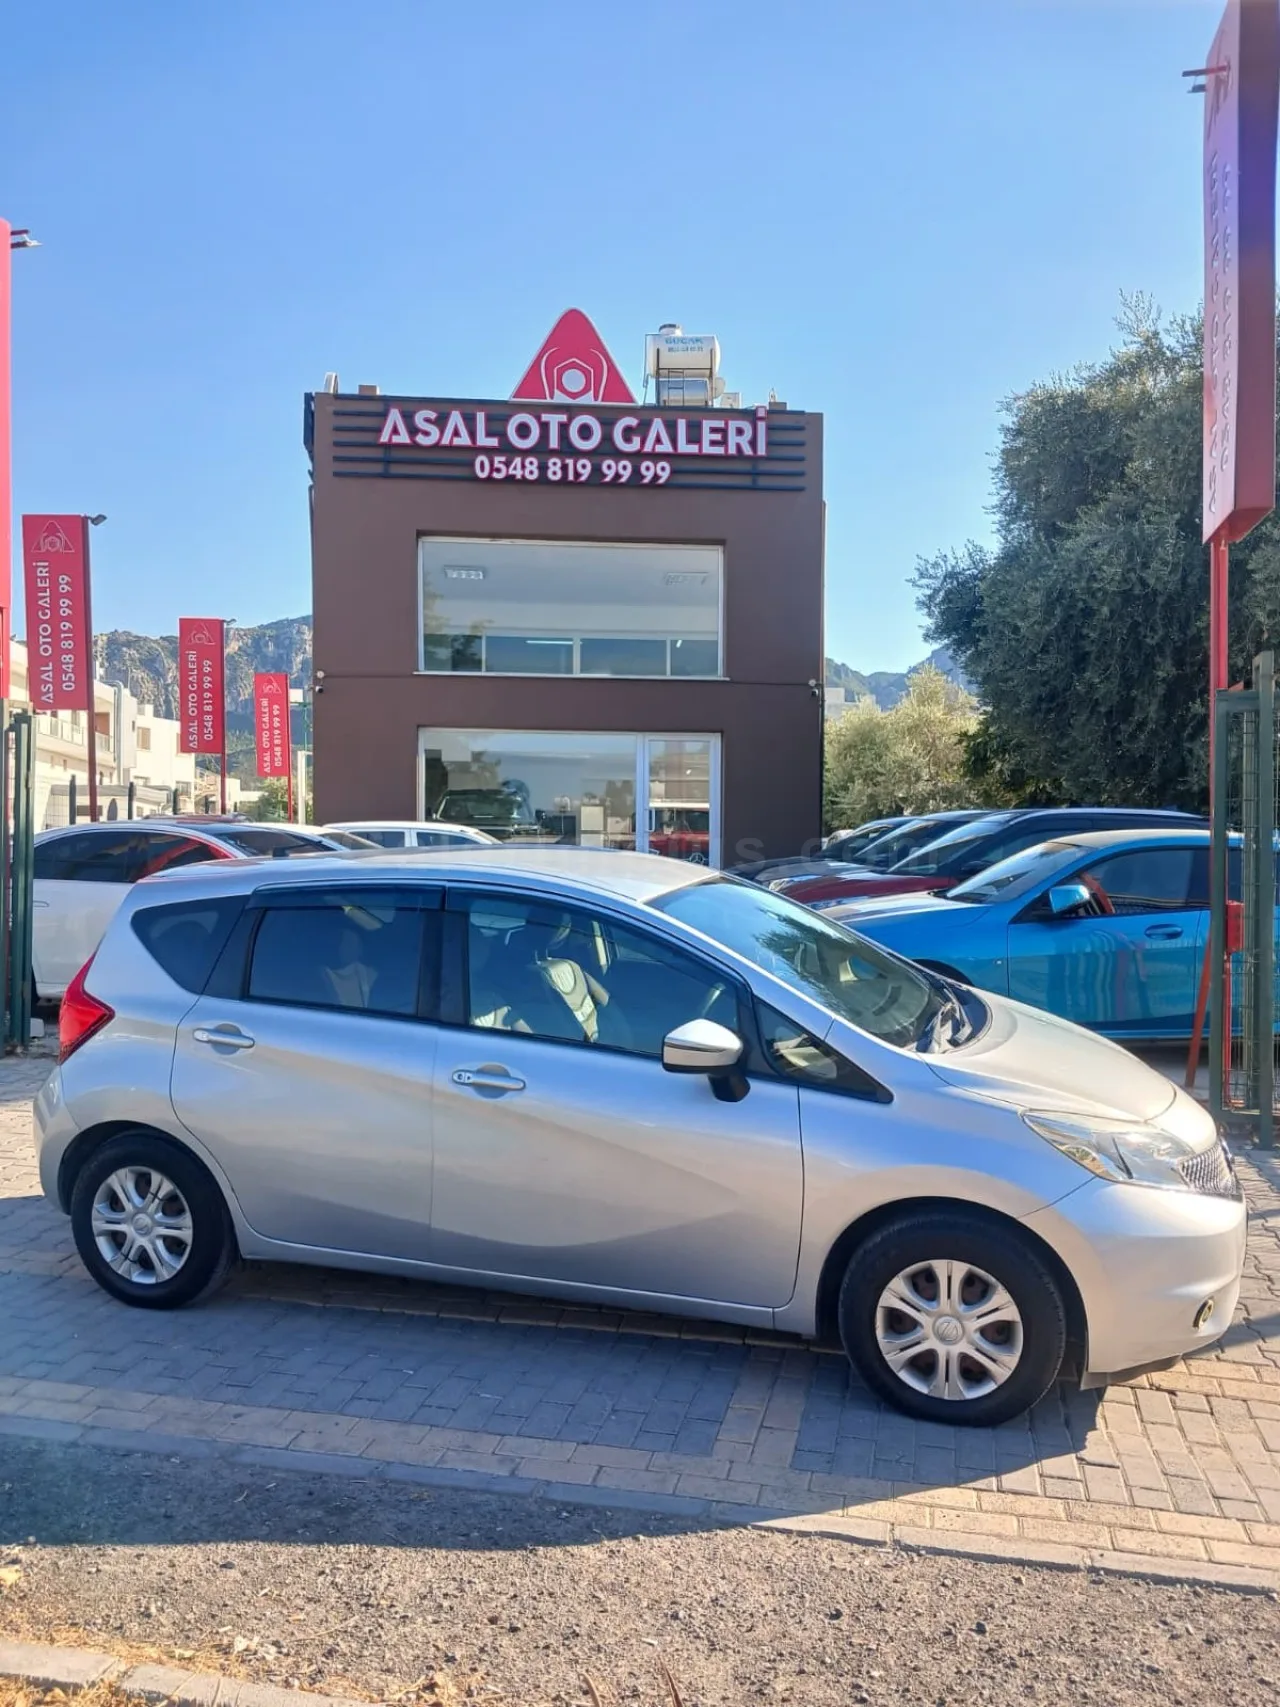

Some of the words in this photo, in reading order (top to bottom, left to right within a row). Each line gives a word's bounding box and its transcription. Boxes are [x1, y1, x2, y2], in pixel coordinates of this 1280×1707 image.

[379, 408, 500, 447] ASAL
[507, 412, 602, 451] OTO
[612, 406, 767, 456] GALERİ
[474, 455, 539, 480] 0548
[547, 457, 592, 482] 819
[601, 459, 632, 483] 99
[640, 461, 671, 485] 99
[33, 562, 51, 619] GALERİ
[58, 575, 72, 593] 99
[59, 598, 73, 616] 99
[39, 624, 53, 656] OTO
[60, 622, 74, 649] 819
[61, 654, 75, 691] 0548
[185, 651, 197, 690] GALERİ
[203, 660, 212, 673] 99
[40, 662, 54, 703] ASAL
[203, 676, 212, 689] 99
[188, 693, 197, 716] OTO
[203, 692, 213, 711] 819
[188, 719, 198, 749] ASAL
[203, 715, 213, 740] 0548
[262, 731, 270, 748] OTO
[263, 751, 271, 773] ASAL
